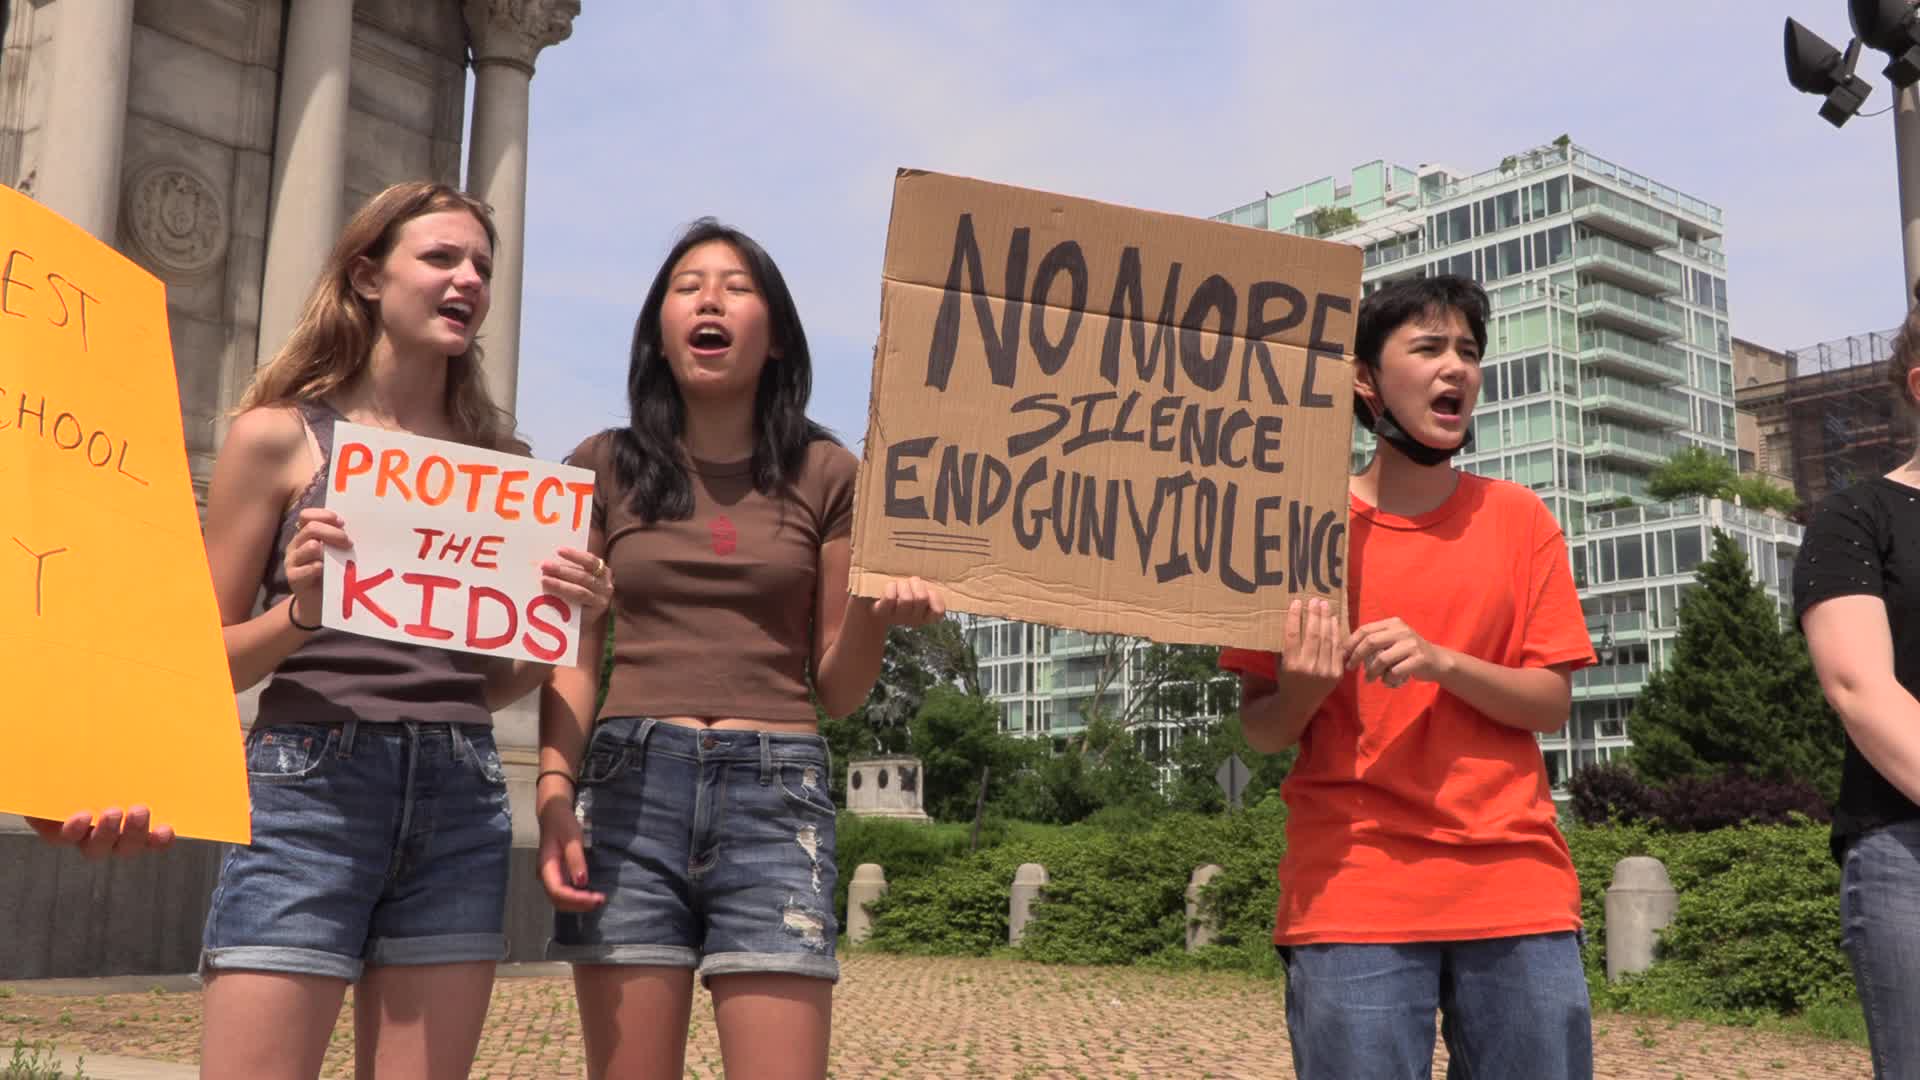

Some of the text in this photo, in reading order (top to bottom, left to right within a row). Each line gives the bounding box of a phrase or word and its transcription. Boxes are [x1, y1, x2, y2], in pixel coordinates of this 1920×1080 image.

[925, 214, 1352, 408] NO MORE
[1007, 390, 1285, 473] SILENCE
[334, 442, 595, 532] PROTECT
[884, 436, 1345, 595] END GUN VIOLENCE
[413, 527, 505, 569] THE
[341, 559, 571, 662] KIDS
